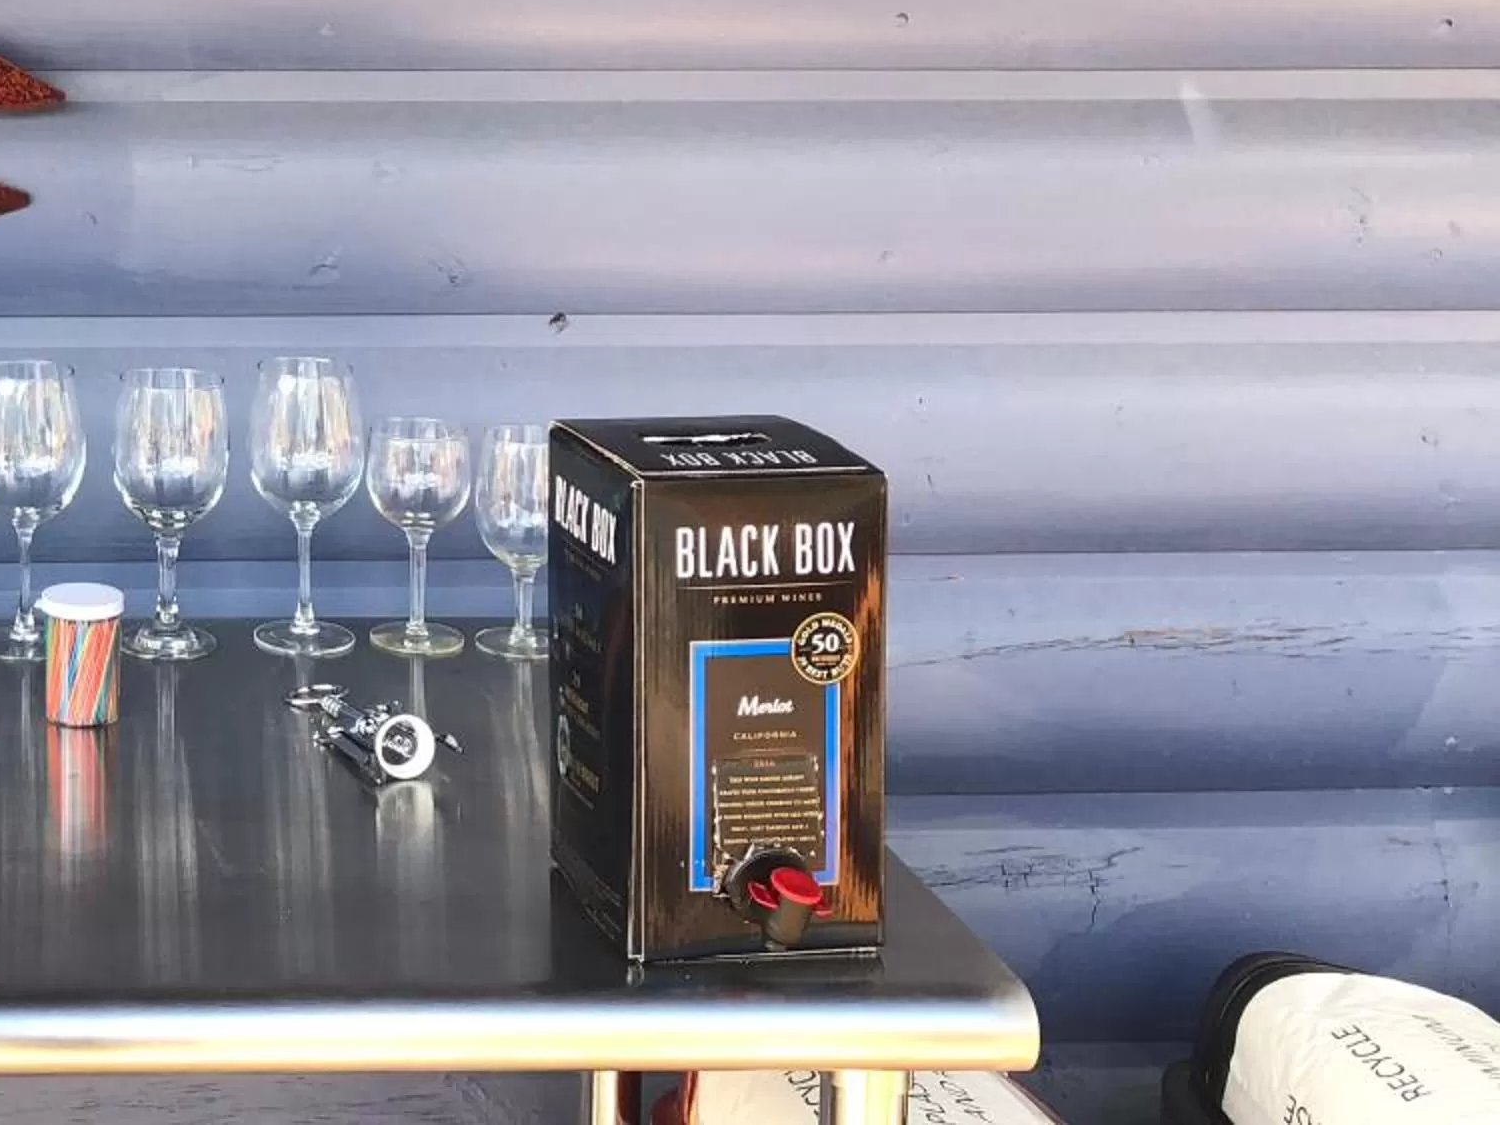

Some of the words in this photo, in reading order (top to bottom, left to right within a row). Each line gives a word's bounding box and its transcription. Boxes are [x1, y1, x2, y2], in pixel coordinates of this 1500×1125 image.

[660, 451, 721, 467] BOX
[722, 450, 818, 466] BLACK
[555, 474, 590, 544] BLACK
[591, 502, 617, 565] BOX
[675, 524, 780, 579] BLACK
[794, 522, 856, 575] BOX
[713, 593, 776, 605] PREMIUM
[781, 592, 823, 603] WINES
[811, 632, 840, 654] 50
[736, 694, 795, 717] Merlot
[732, 730, 797, 741] CALIFORNIA
[1331, 1024, 1432, 1102] RECYCLE
